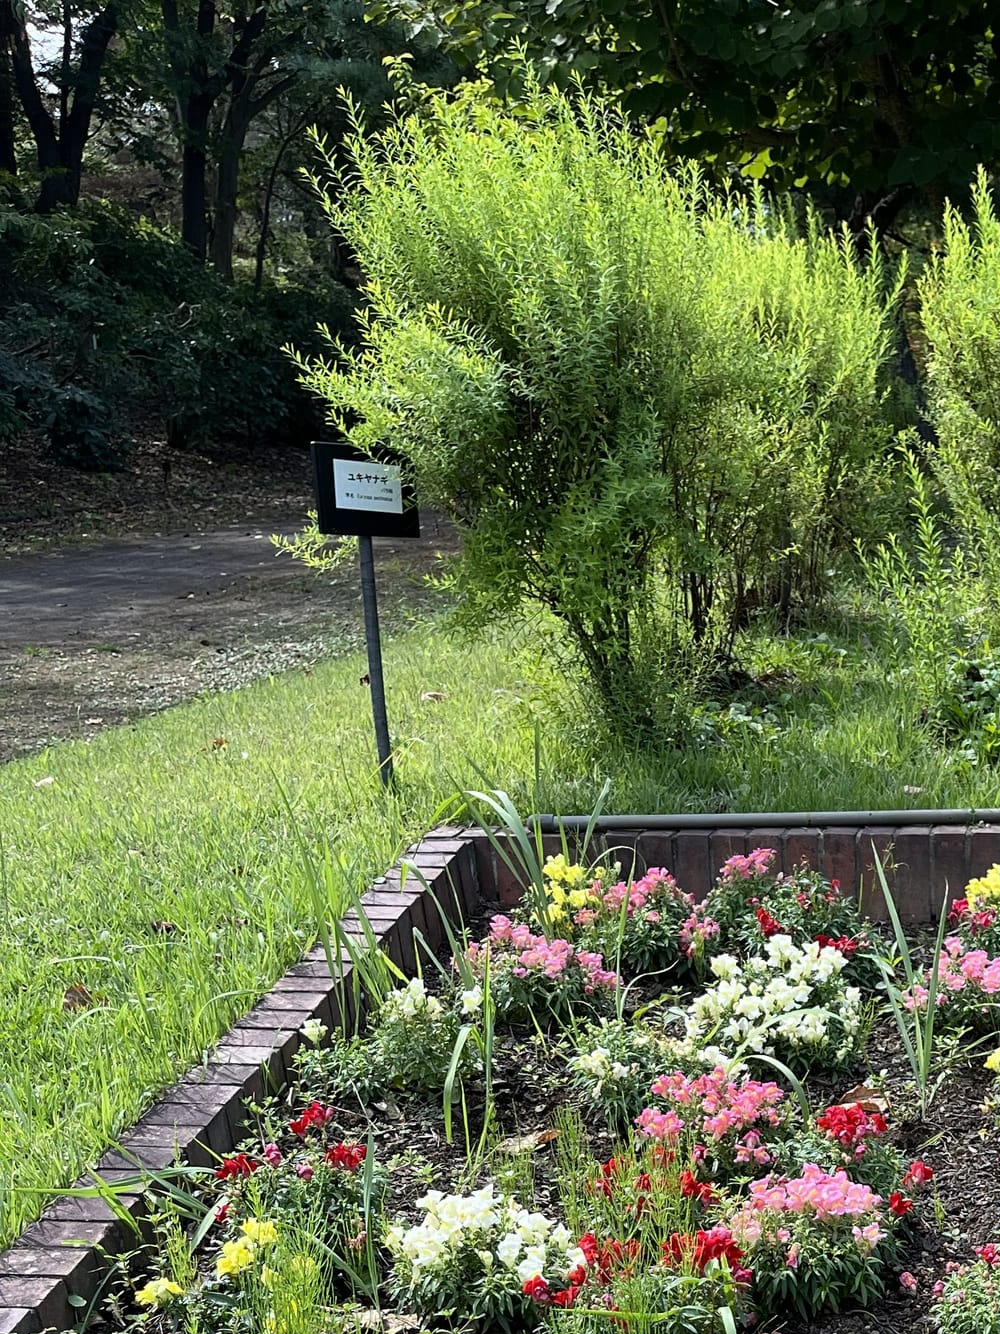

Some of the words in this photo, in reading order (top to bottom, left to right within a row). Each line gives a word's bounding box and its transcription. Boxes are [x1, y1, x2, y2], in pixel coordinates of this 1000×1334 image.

[348, 473, 388, 485] ユキヤナギ
